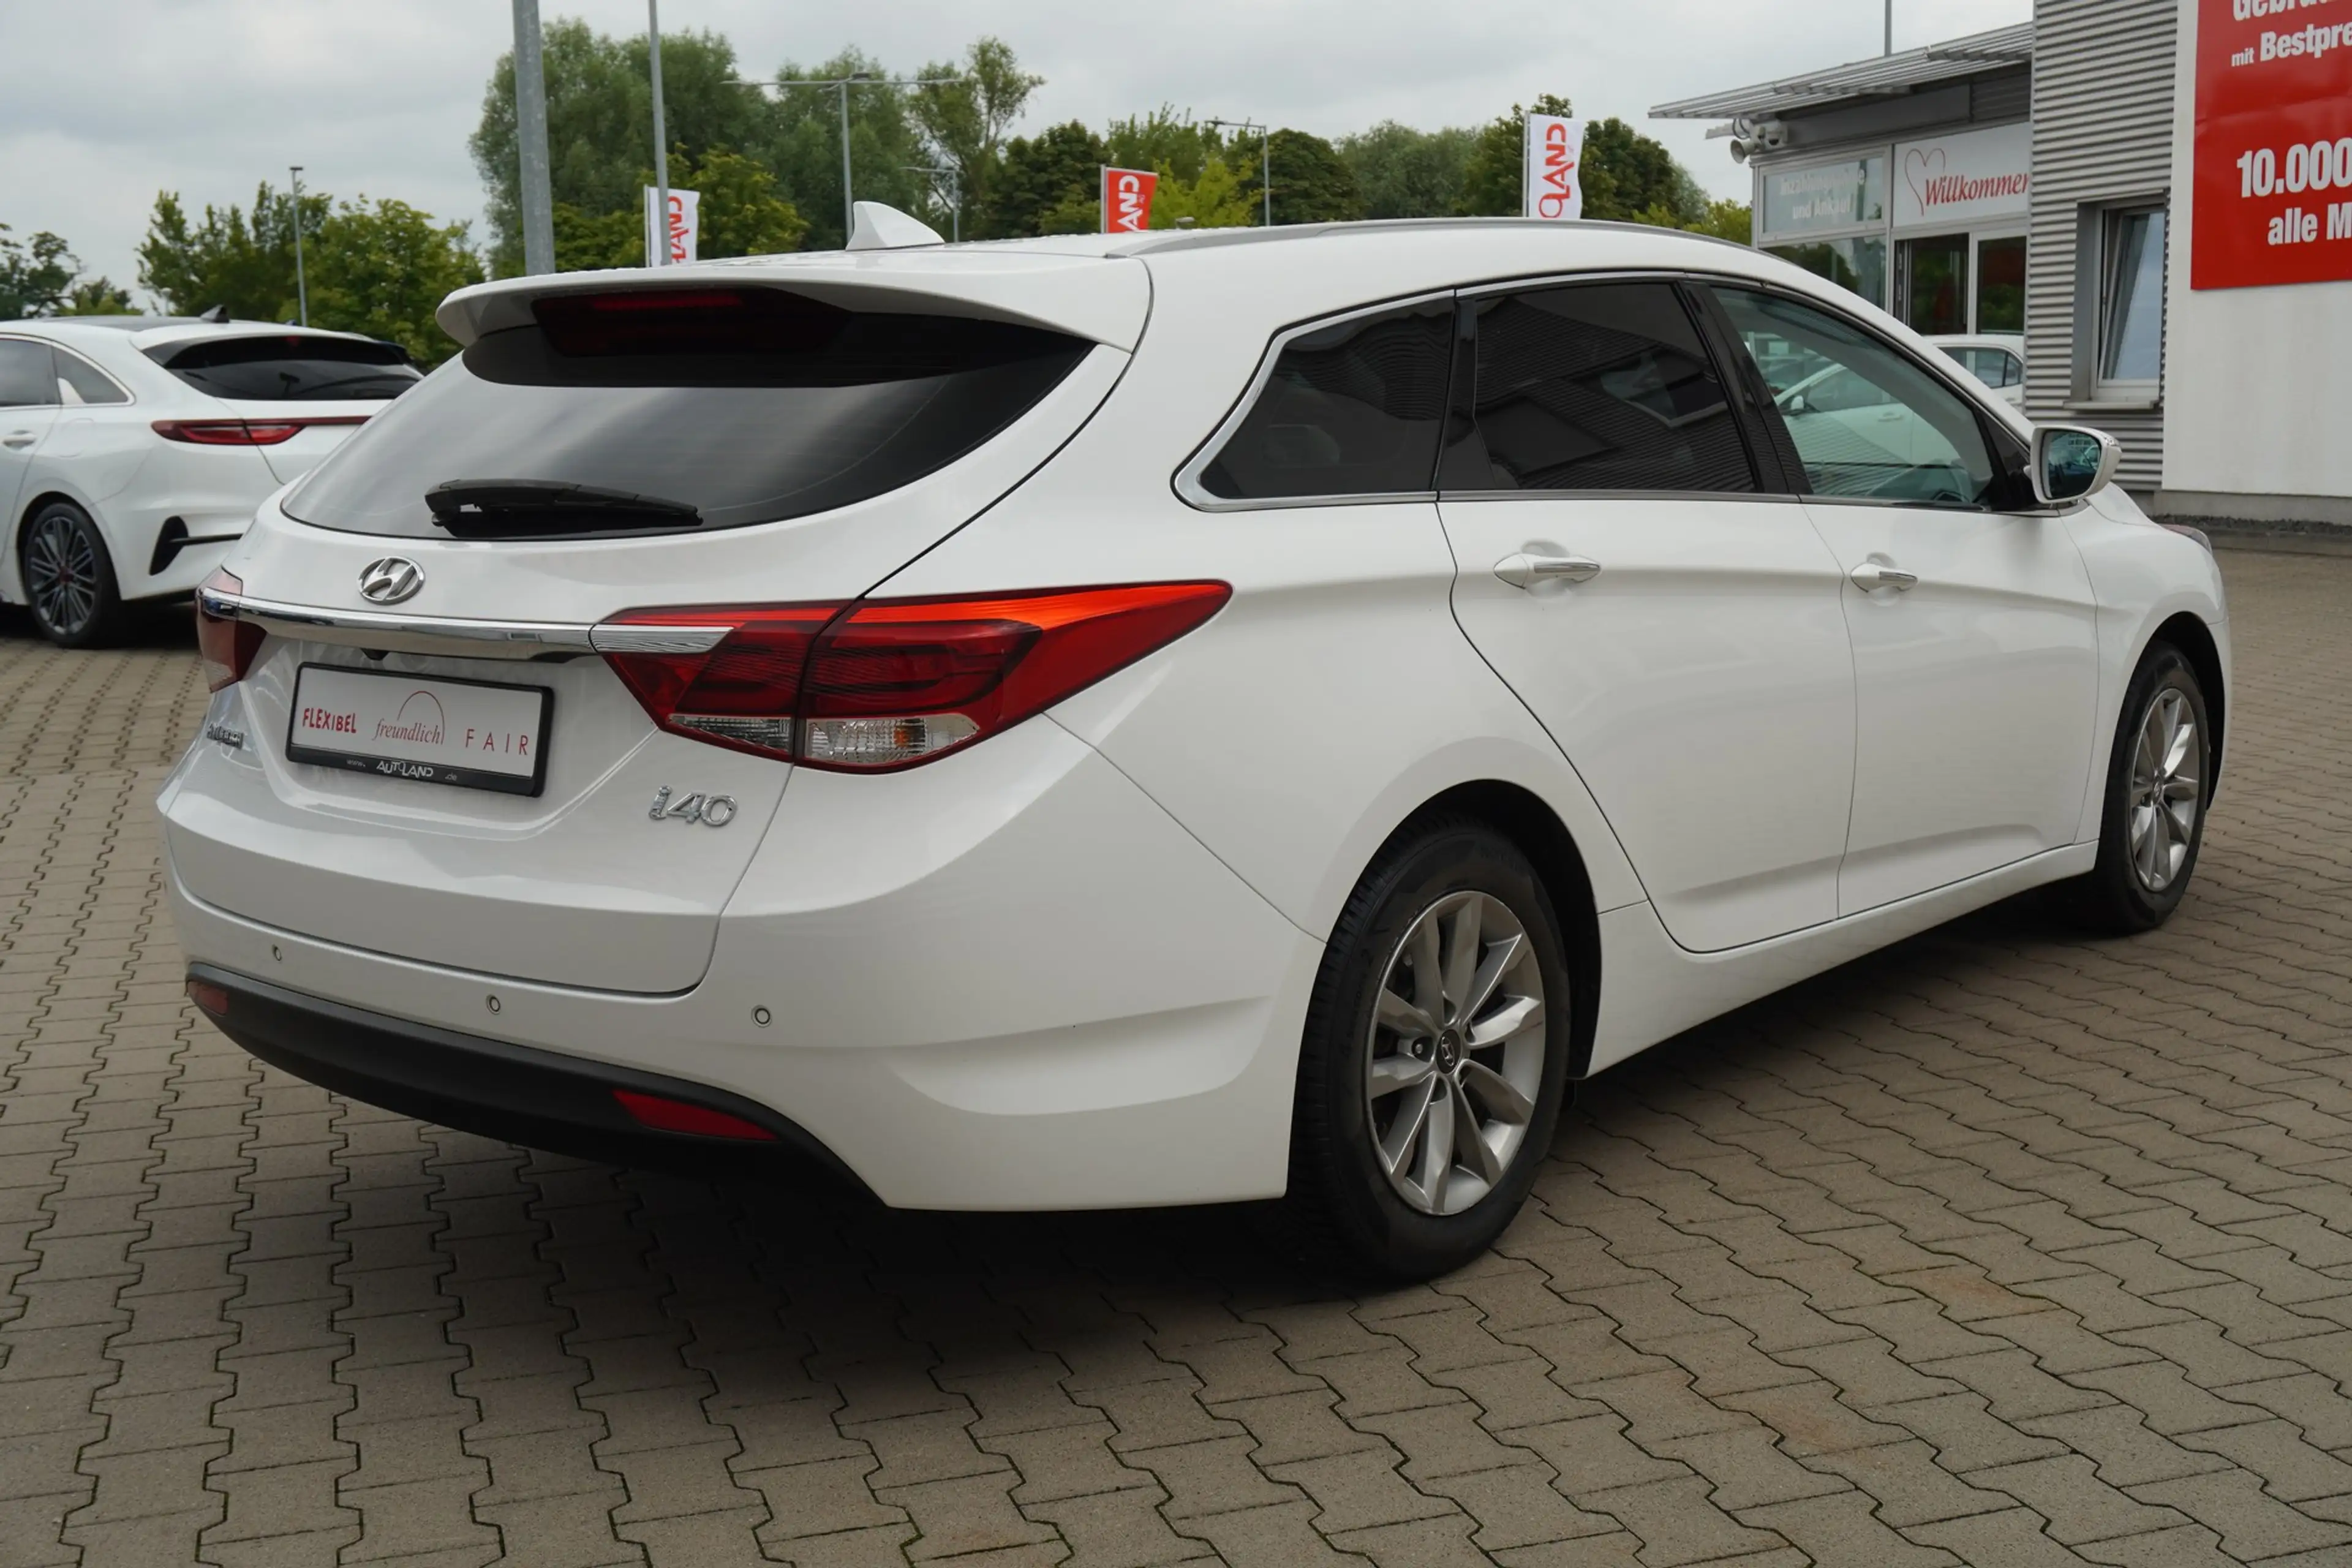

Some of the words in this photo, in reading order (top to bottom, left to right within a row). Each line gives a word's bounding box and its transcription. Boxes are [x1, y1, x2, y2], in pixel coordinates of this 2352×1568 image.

[2231, 47, 2255, 67] mit
[2260, 22, 2352, 61] Bestpre
[2237, 137, 2352, 198] 10.000
[2267, 207, 2318, 245] alle
[302, 707, 357, 734] FLEXIBEL
[371, 717, 441, 745] freundlich
[466, 728, 529, 756] FAIR
[376, 760, 434, 778] AUTOLAND
[649, 784, 738, 827] i40
